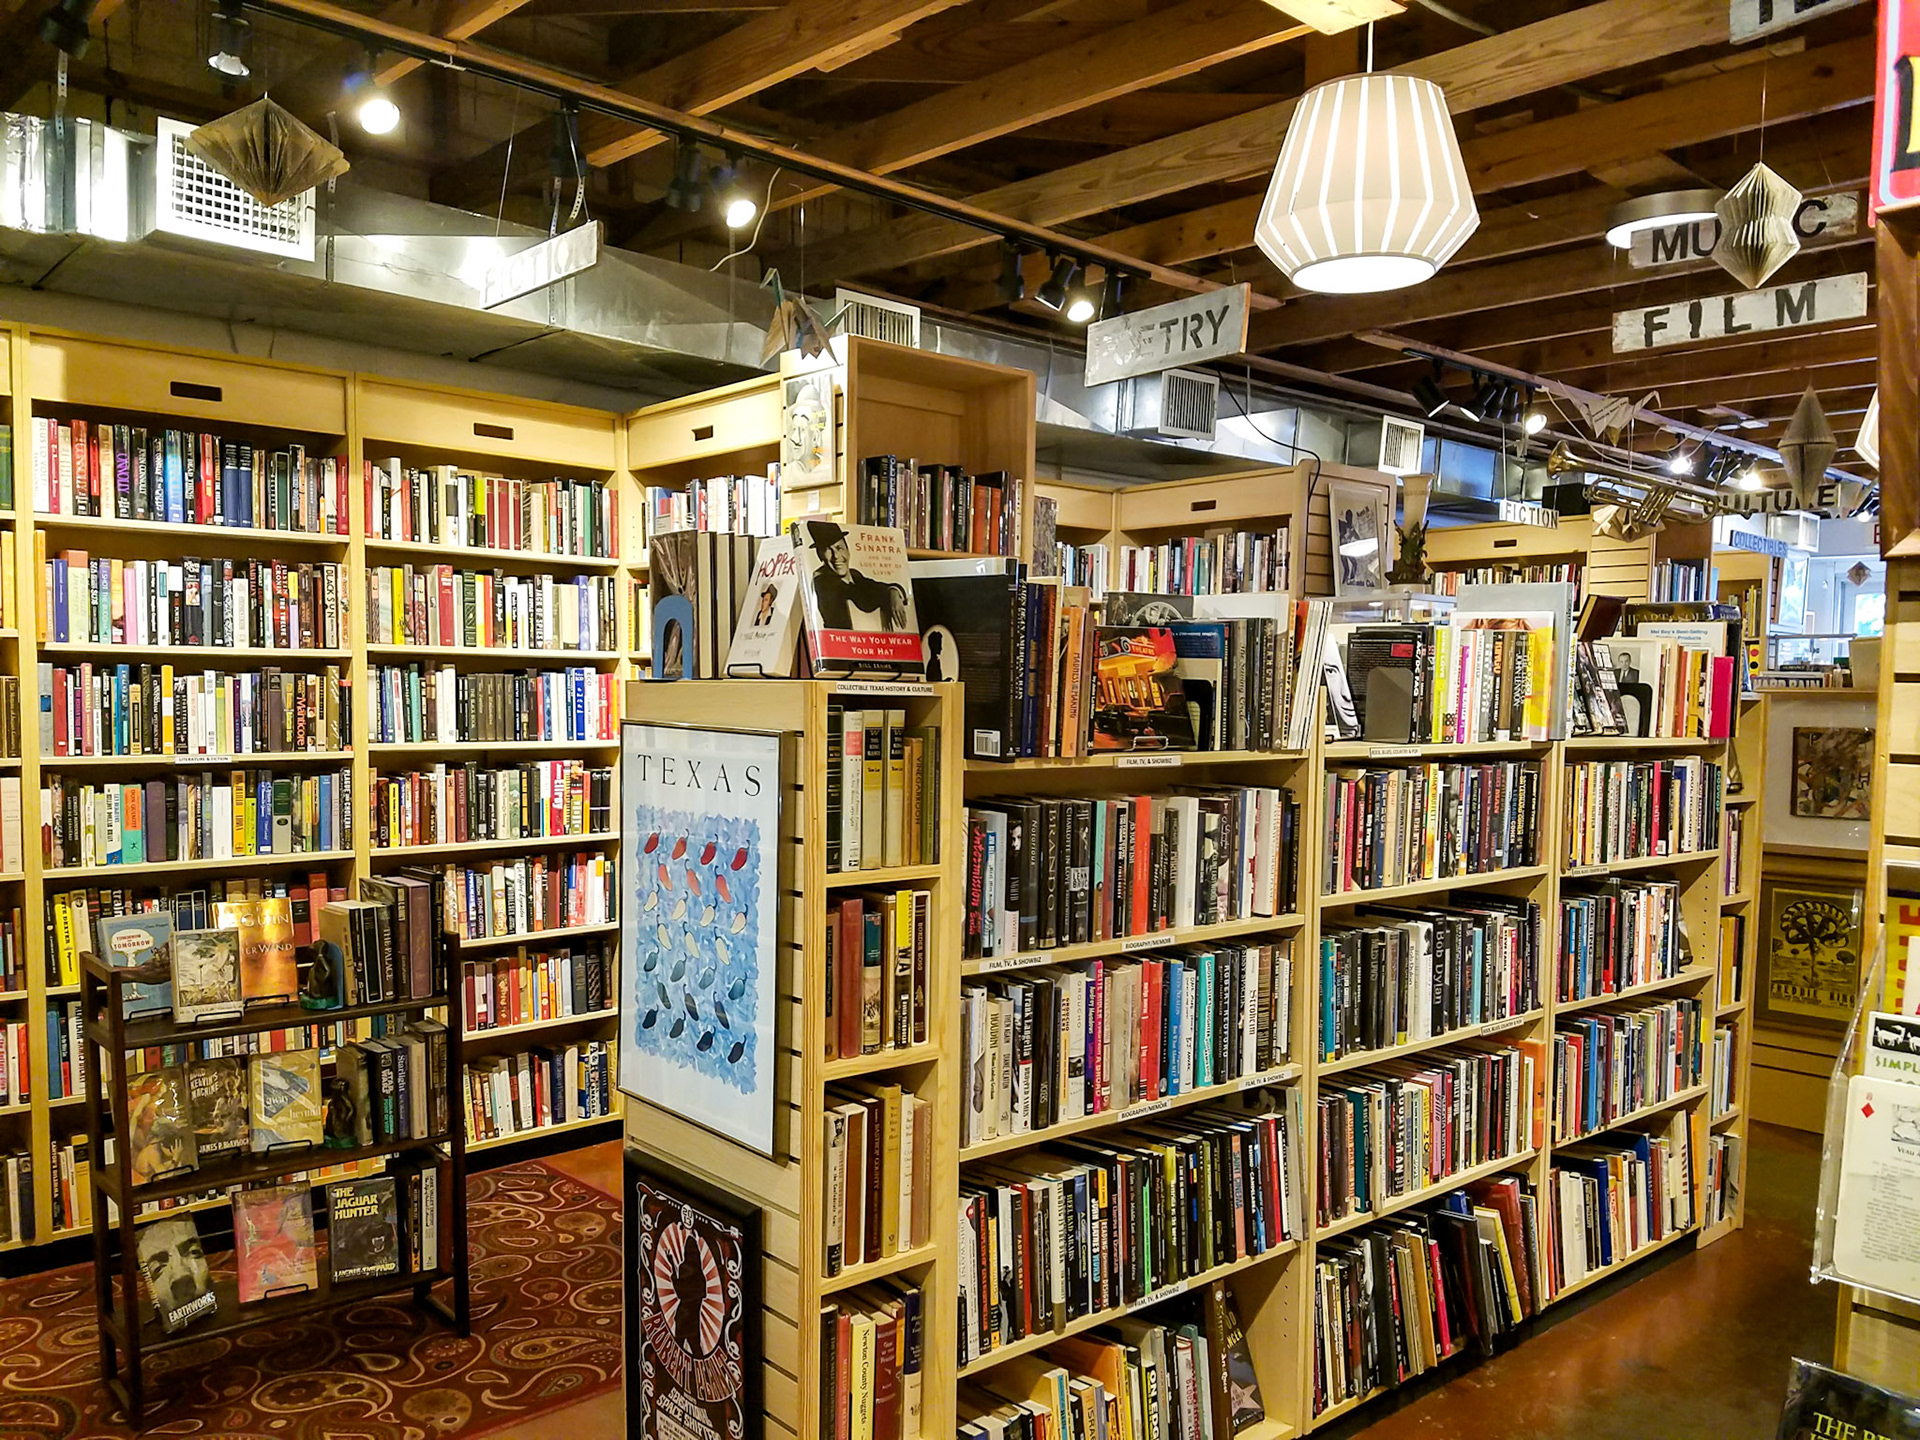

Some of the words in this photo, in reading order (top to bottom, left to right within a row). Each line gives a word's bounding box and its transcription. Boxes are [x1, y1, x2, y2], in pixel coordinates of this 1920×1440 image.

[1652, 199, 1828, 263] MUC
[1643, 282, 1817, 347] FILM
[138, 464, 146, 495] CONNOLLY
[1703, 484, 1837, 515] ULTUE
[1505, 502, 1558, 529] FICTION
[855, 543, 902, 554] SINATRA
[860, 532, 895, 543] FRANK
[1734, 531, 1788, 557] COLLECTIBLES
[755, 552, 795, 585] HOPPER
[326, 570, 335, 595] BLACK
[326, 597, 335, 618] SUN
[536, 608, 542, 618] OF
[829, 634, 847, 643] THE
[849, 635, 866, 644] WAY
[869, 636, 887, 645] YOU
[888, 637, 912, 646] WEAR
[851, 646, 874, 655] YOUR
[877, 647, 894, 656] HAT
[1753, 678, 1785, 688] HARD
[1788, 679, 1820, 688] RAIN
[1070, 690, 1078, 719] MAKING
[296, 696, 307, 746] Manticore
[637, 753, 762, 798] TEXAS
[553, 779, 563, 809] Ellroy
[915, 757, 924, 826] VINEGARROON
[1365, 814, 1373, 827] Billy
[1365, 828, 1373, 845] Bragg
[1047, 809, 1057, 911] BRANDO
[507, 886, 515, 915] MIDDLESEX
[240, 913, 289, 928] GUIN
[113, 939, 150, 949] TOMORROW
[116, 933, 142, 941] TOMORROW
[384, 928, 392, 946] THE
[1125, 937, 1172, 950] BIOGRAPHY/MEMOIR
[1435, 931, 1444, 953] Bob
[385, 947, 394, 981] PALACE
[989, 960, 1003, 969] FILM,
[1004, 959, 1012, 967] TV,
[1018, 957, 1042, 965] SHOWBIZ
[1433, 963, 1444, 1005] Dylan
[1770, 983, 1818, 999] FREDDIE
[1024, 992, 1033, 1016] Frank
[989, 1012, 999, 1049] HOUDINI
[1023, 1016, 1032, 1057] Langella
[190, 1072, 219, 1090] KELVIN'S
[397, 1055, 406, 1092] Starlight
[191, 1082, 219, 1099] MACHINE
[1121, 1101, 1168, 1119] BIOGRAPHY/MEMOIR
[1233, 1150, 1242, 1174] SAINT
[1395, 1141, 1404, 1173] MAN
[334, 1186, 354, 1198] THE
[335, 1194, 378, 1209] JAGUAR
[1234, 1176, 1244, 1209] CINEMA
[335, 1204, 379, 1220] HUNTER
[1090, 1198, 1099, 1218] JOHN
[1091, 1220, 1100, 1253] WAYNE'S
[1100, 1221, 1108, 1250] READING
[959, 1244, 967, 1277] WAYNE
[1092, 1254, 1101, 1283] WORLD
[1101, 1279, 1109, 1307] DESIGNS
[168, 1291, 216, 1324] EARTHWORKS
[861, 1328, 870, 1355] Newton
[860, 1358, 869, 1386] County
[656, 1394, 683, 1420] SPACE
[858, 1387, 868, 1425] Nuggets
[1813, 1411, 1857, 1440] THE
